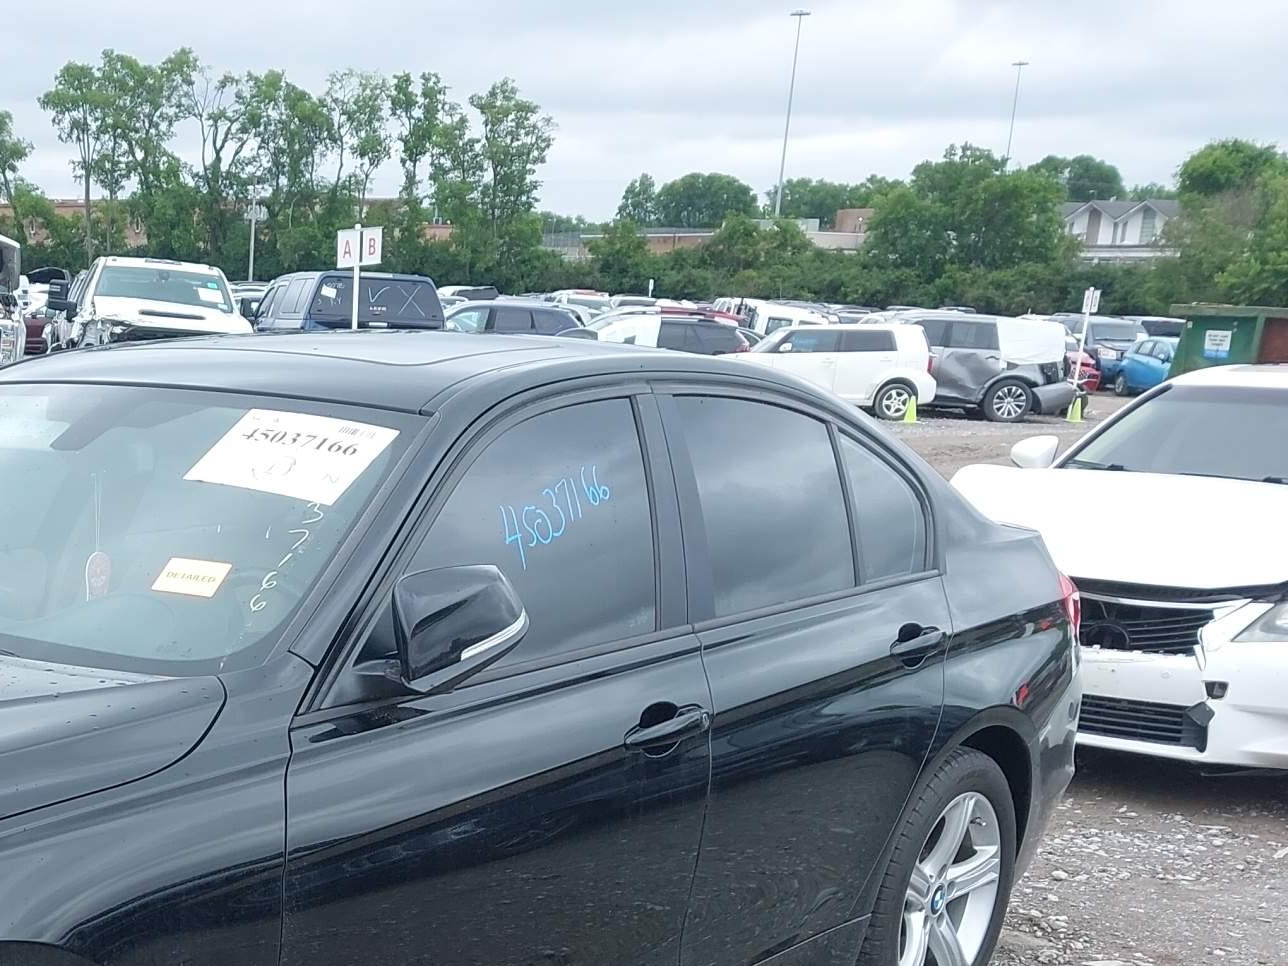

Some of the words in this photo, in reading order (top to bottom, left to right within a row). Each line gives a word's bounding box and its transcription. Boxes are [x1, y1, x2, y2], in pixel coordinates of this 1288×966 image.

[342, 239, 352, 259] A
[368, 237, 376, 256] B
[241, 427, 359, 456] 45037166
[498, 465, 610, 571] 45037166
